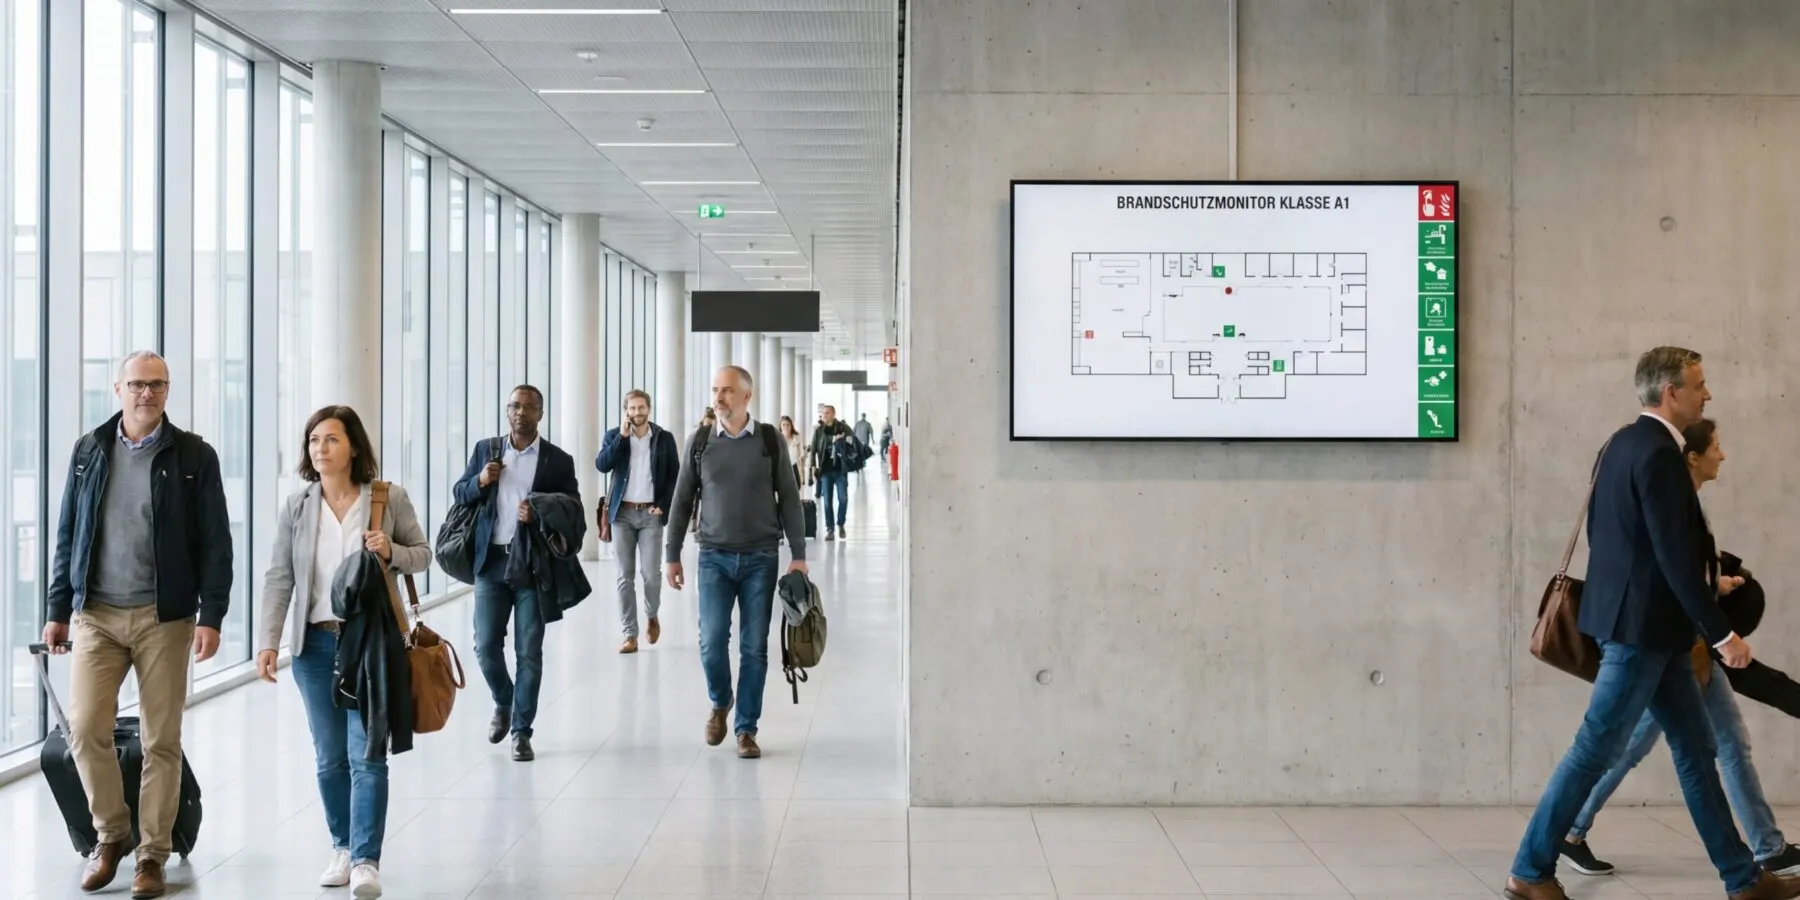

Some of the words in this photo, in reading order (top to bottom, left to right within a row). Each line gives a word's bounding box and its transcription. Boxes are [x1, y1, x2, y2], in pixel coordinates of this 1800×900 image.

[1117, 195, 1276, 210] BRANDSCHUTZMONITOR
[1279, 195, 1331, 210] KLASSE
[1334, 196, 1350, 210] A1
